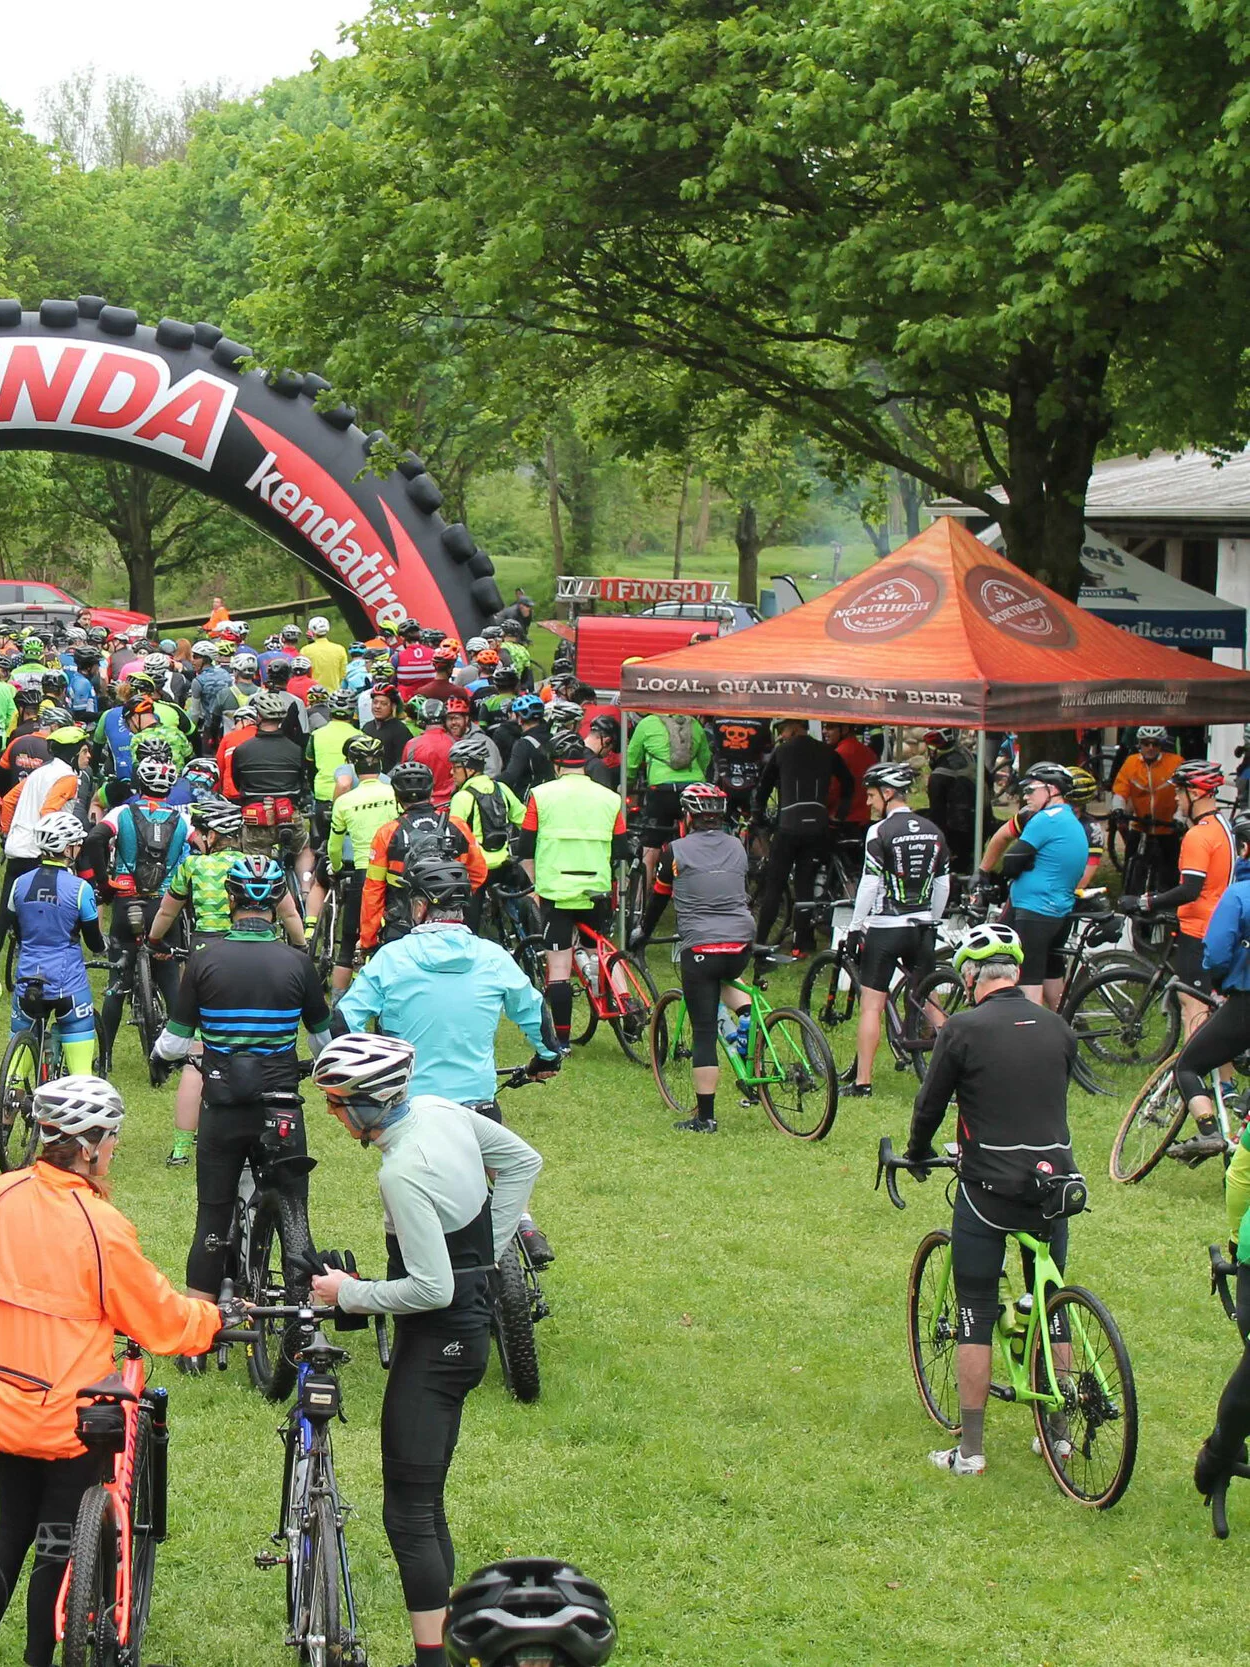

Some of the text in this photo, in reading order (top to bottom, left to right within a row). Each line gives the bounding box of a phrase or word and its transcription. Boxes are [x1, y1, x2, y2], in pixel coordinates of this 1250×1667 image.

[1081, 546, 1125, 567] er's
[617, 581, 697, 600] FINISH
[833, 601, 931, 619] NORTH HIGH
[988, 605, 1023, 625] NORTH
[1020, 598, 1047, 614] HIGH
[636, 677, 964, 706] LOCAL, QUALITY, CRAFT BEER
[1060, 689, 1188, 707] WWW.NORTHHIGHBREWING.COM
[352, 800, 394, 811] TREK
[908, 843, 927, 851] Lefty
